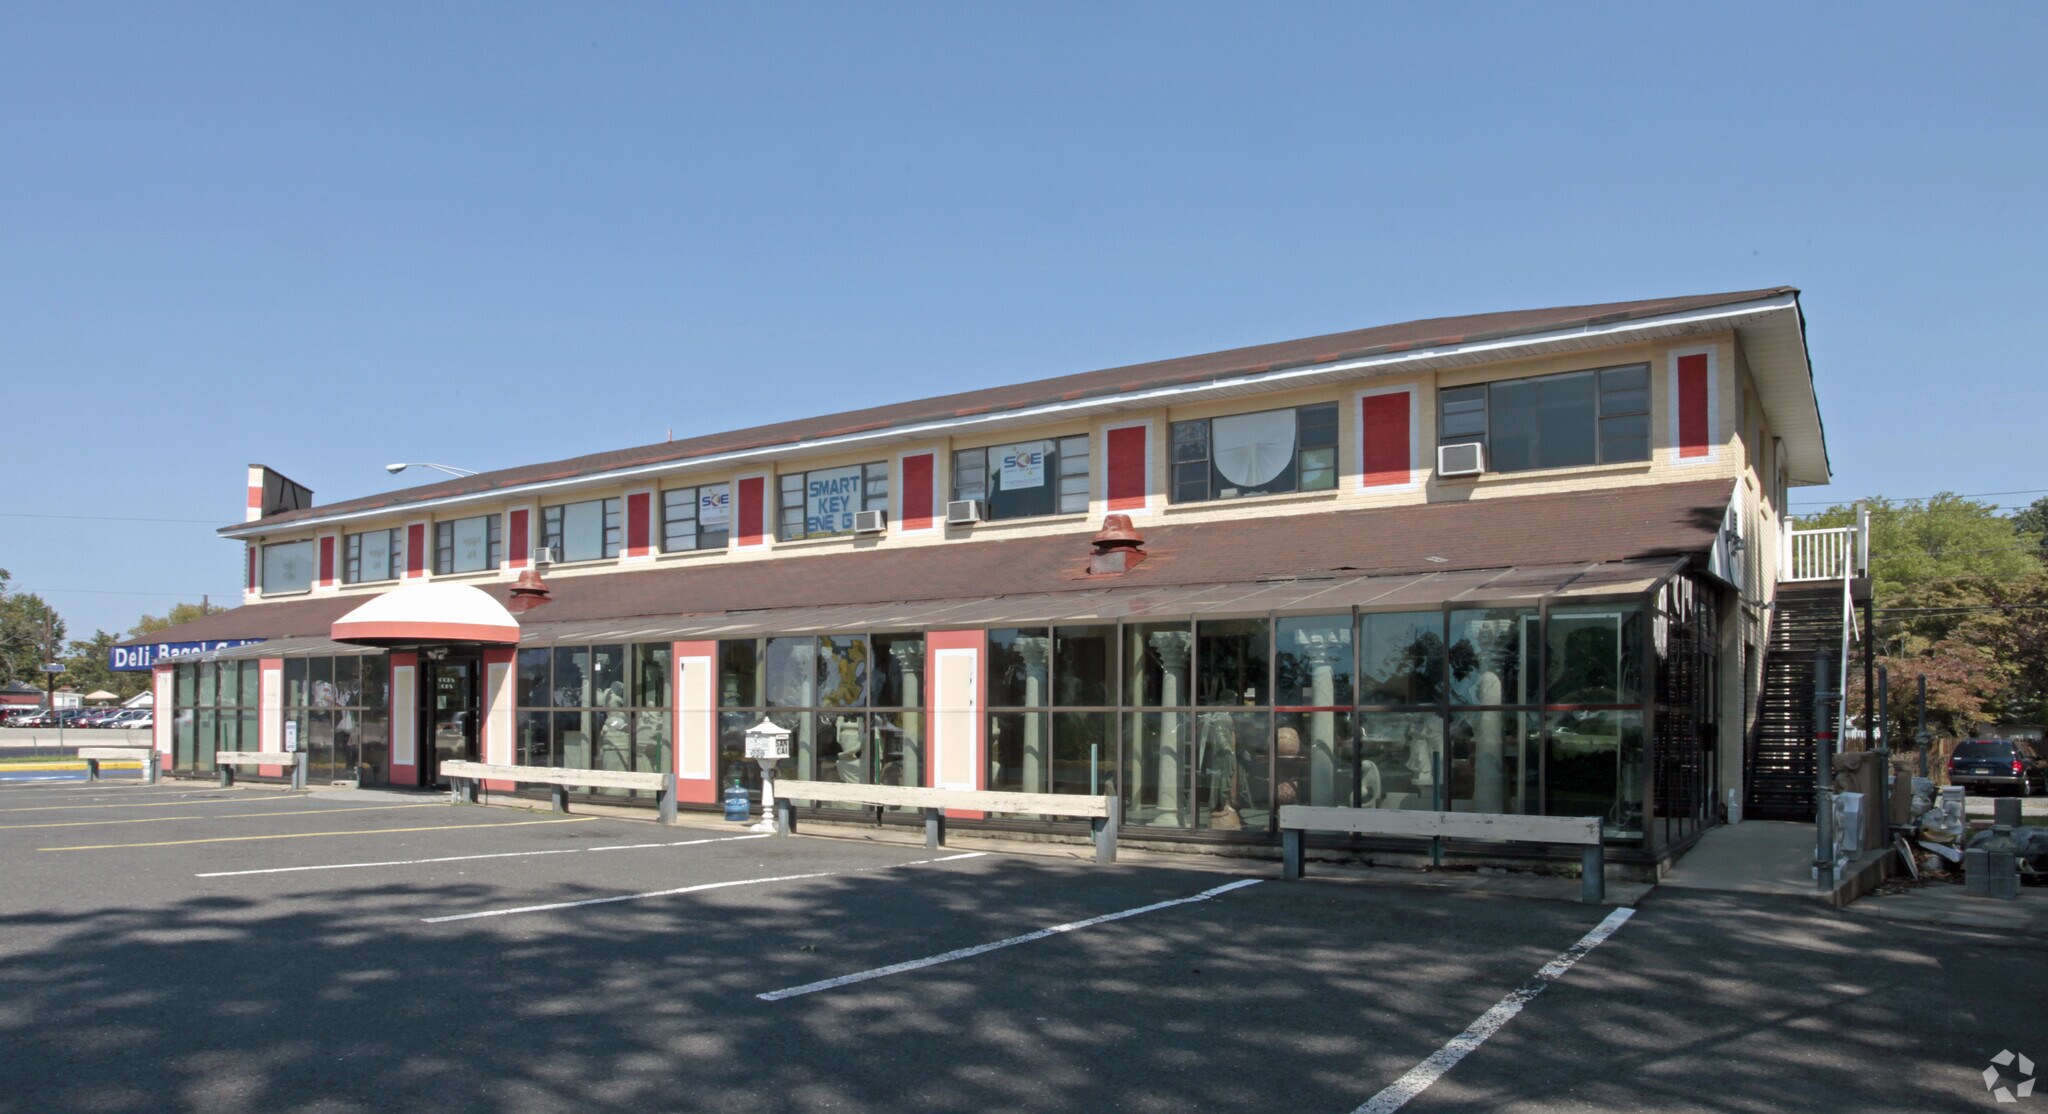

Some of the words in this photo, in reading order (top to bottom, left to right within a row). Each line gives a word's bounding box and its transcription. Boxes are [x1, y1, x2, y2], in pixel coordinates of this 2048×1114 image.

[809, 476, 860, 497] SMART
[818, 495, 850, 515] KEY
[115, 646, 150, 667] Deli
